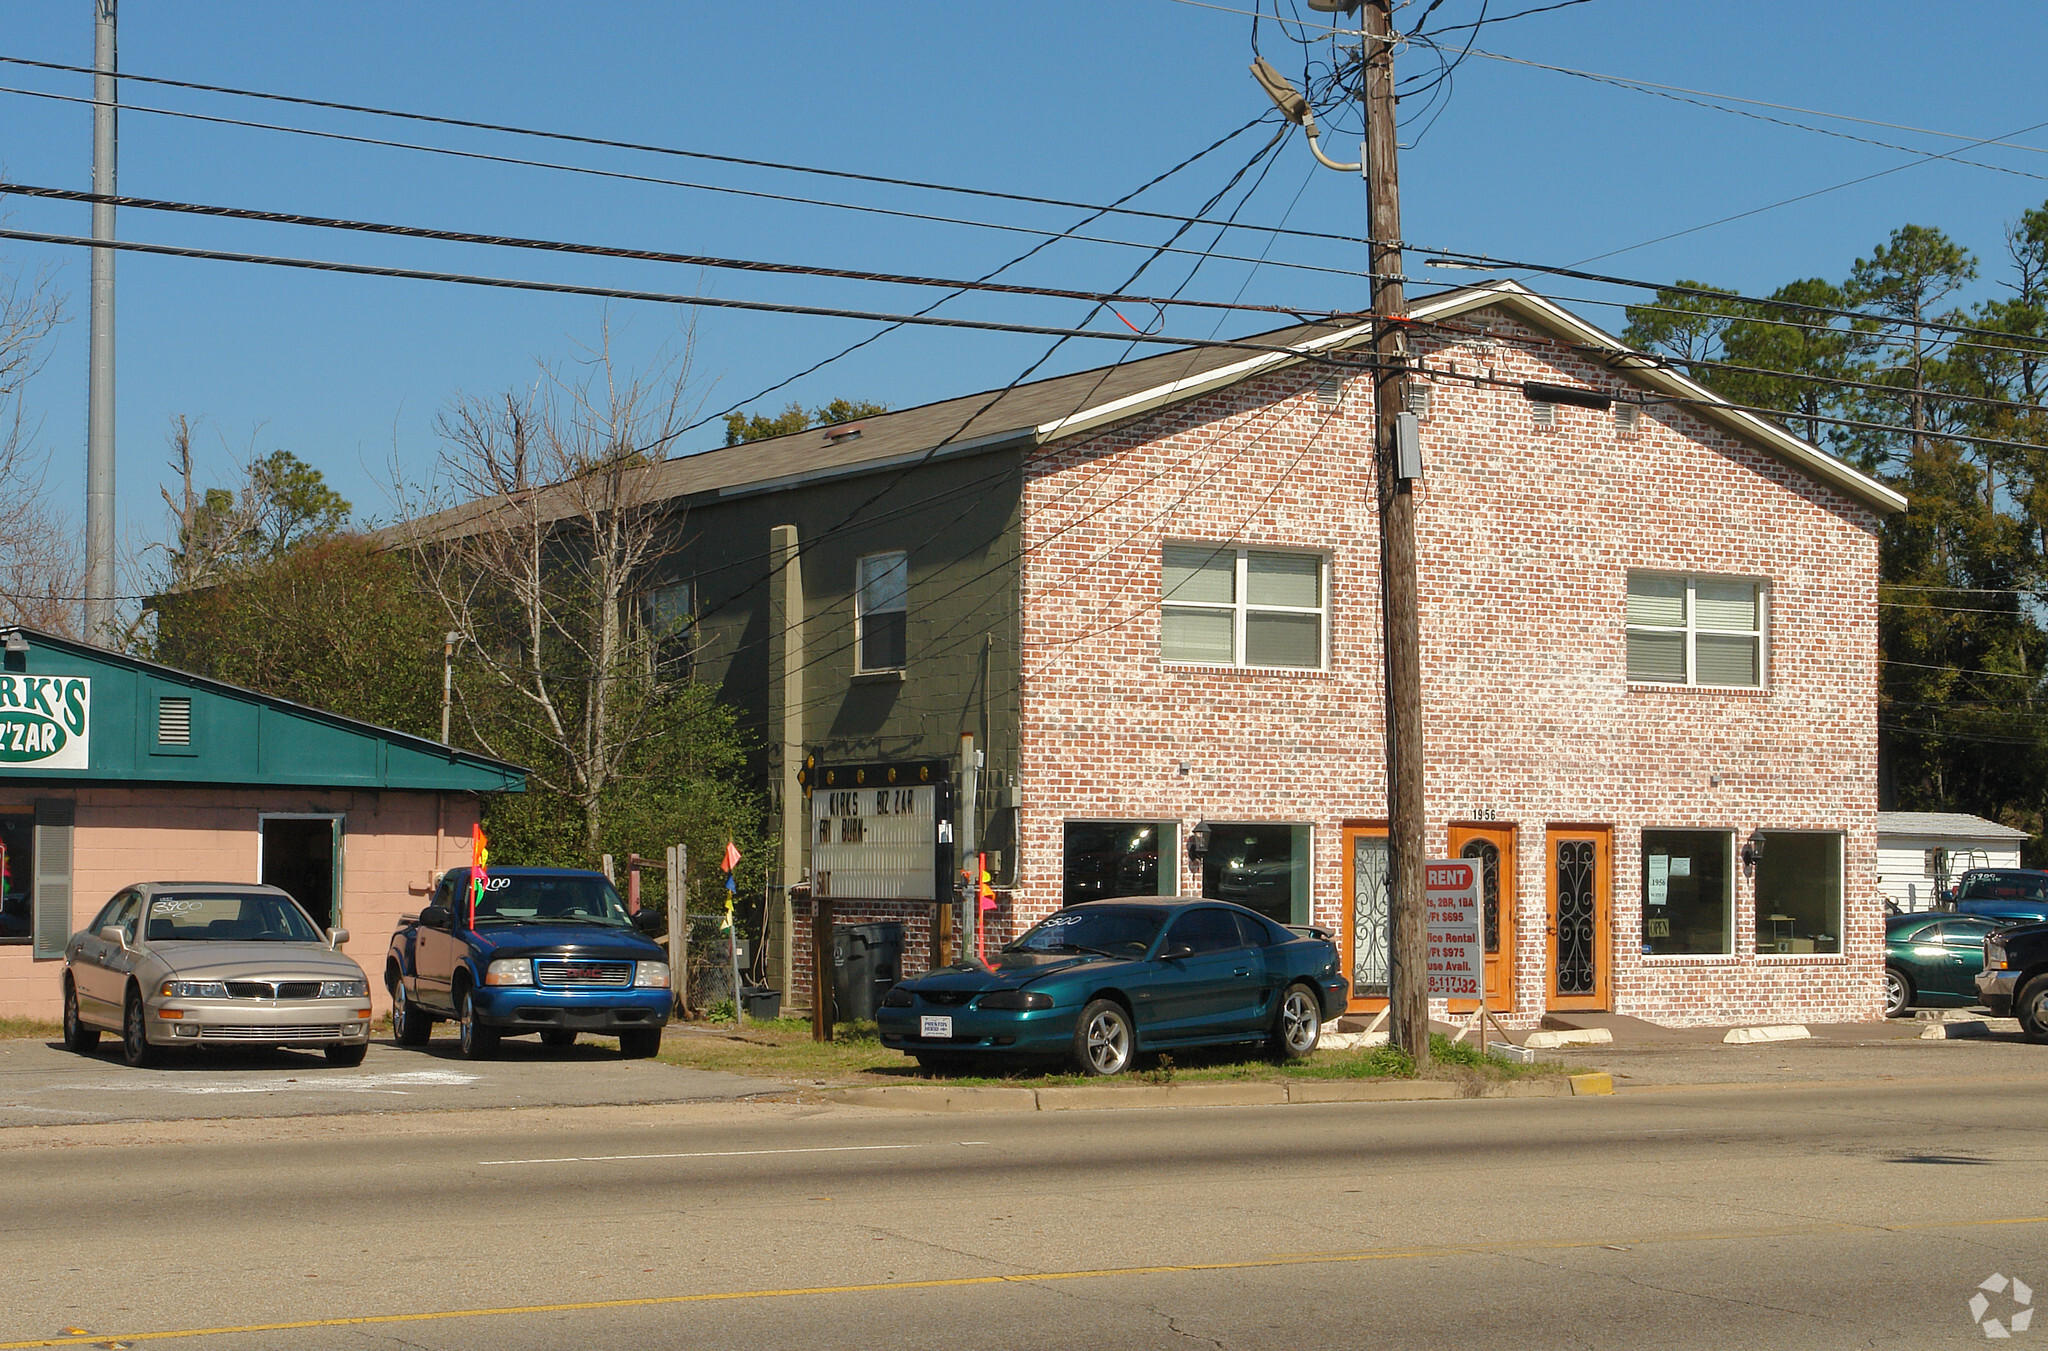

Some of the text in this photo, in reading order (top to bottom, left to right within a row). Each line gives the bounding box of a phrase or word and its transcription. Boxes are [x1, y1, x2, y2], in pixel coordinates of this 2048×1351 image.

[829, 792, 858, 816] KIRKS
[1472, 809, 1496, 820] 1956
[1428, 870, 1466, 886] RENT
[153, 900, 203, 913] 3900
[1438, 897, 1456, 909] 2BR,
[1458, 897, 1474, 908] 1BA
[1442, 912, 1464, 922] $695
[1650, 921, 1668, 935] OPEN
[1445, 932, 1476, 943] Rental
[1442, 947, 1465, 958] $975
[1445, 960, 1471, 971] Avail.
[566, 969, 603, 978] GMC
